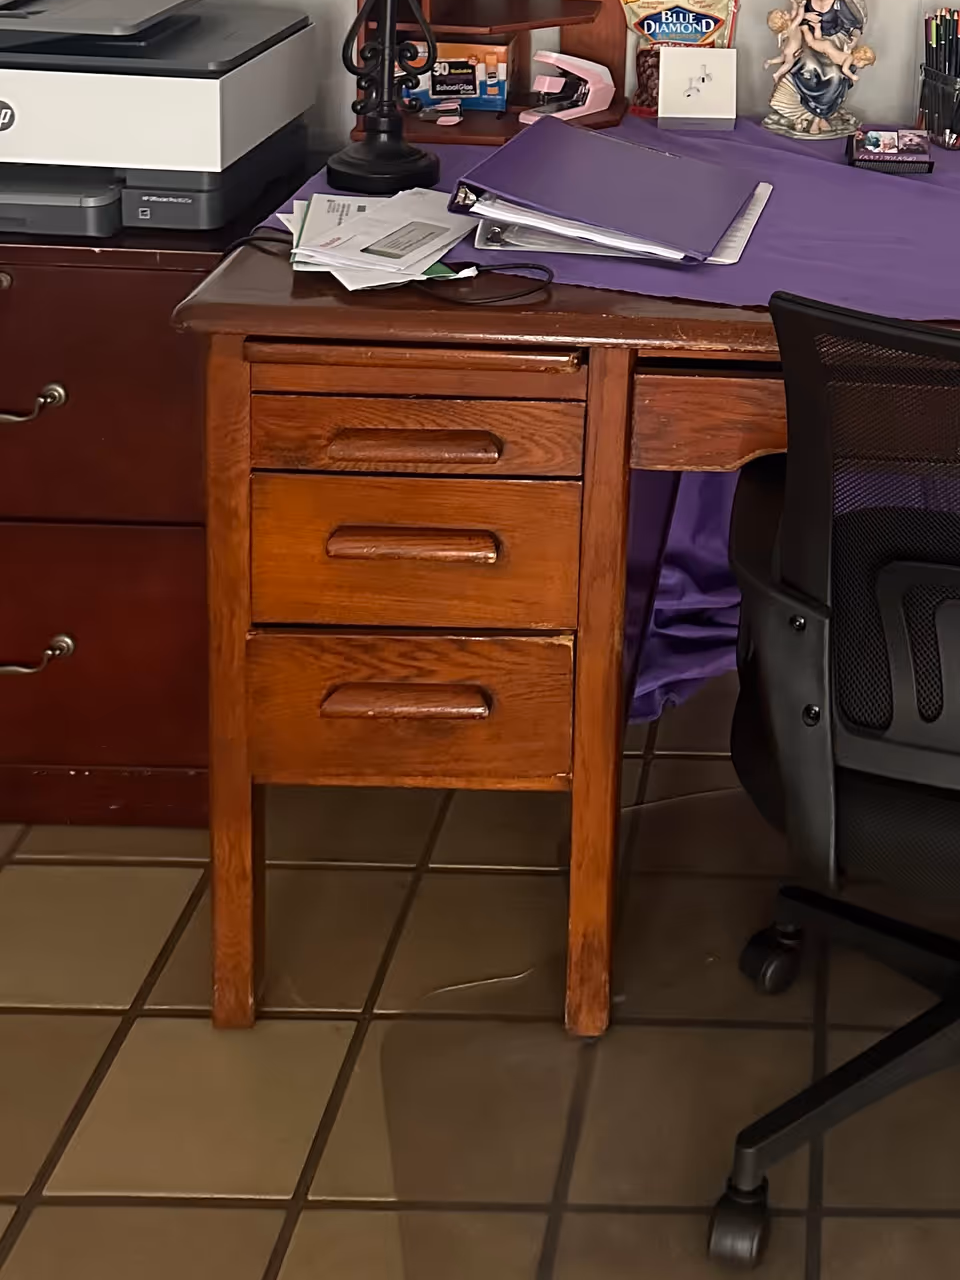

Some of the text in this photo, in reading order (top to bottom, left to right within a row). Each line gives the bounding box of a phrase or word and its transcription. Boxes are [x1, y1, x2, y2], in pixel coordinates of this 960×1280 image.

[661, 10, 697, 24] BLUE
[643, 18, 715, 34] DIAMOND
[432, 62, 450, 75] 30
[436, 83, 458, 91] School
